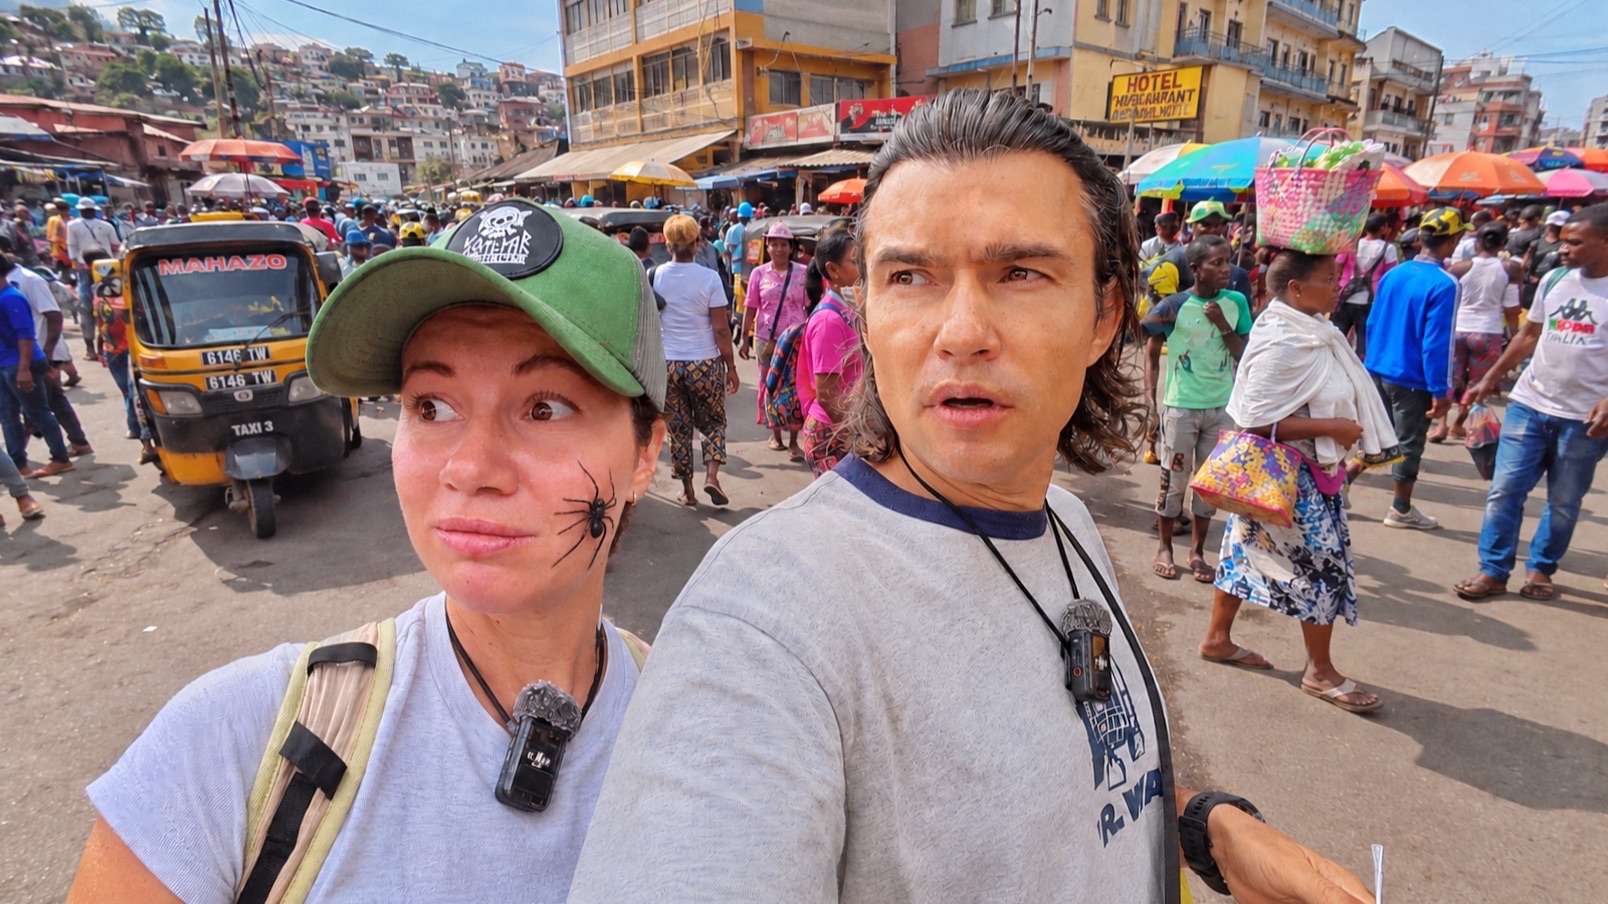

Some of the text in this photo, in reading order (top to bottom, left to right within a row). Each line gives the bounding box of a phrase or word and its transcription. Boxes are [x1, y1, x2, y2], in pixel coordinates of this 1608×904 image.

[1126, 71, 1183, 93] HOTEL
[158, 253, 288, 276] MAHAZO
[206, 346, 267, 365] 6146 TW
[209, 369, 273, 390] 6146 TW
[231, 420, 275, 437] TAXI 3
